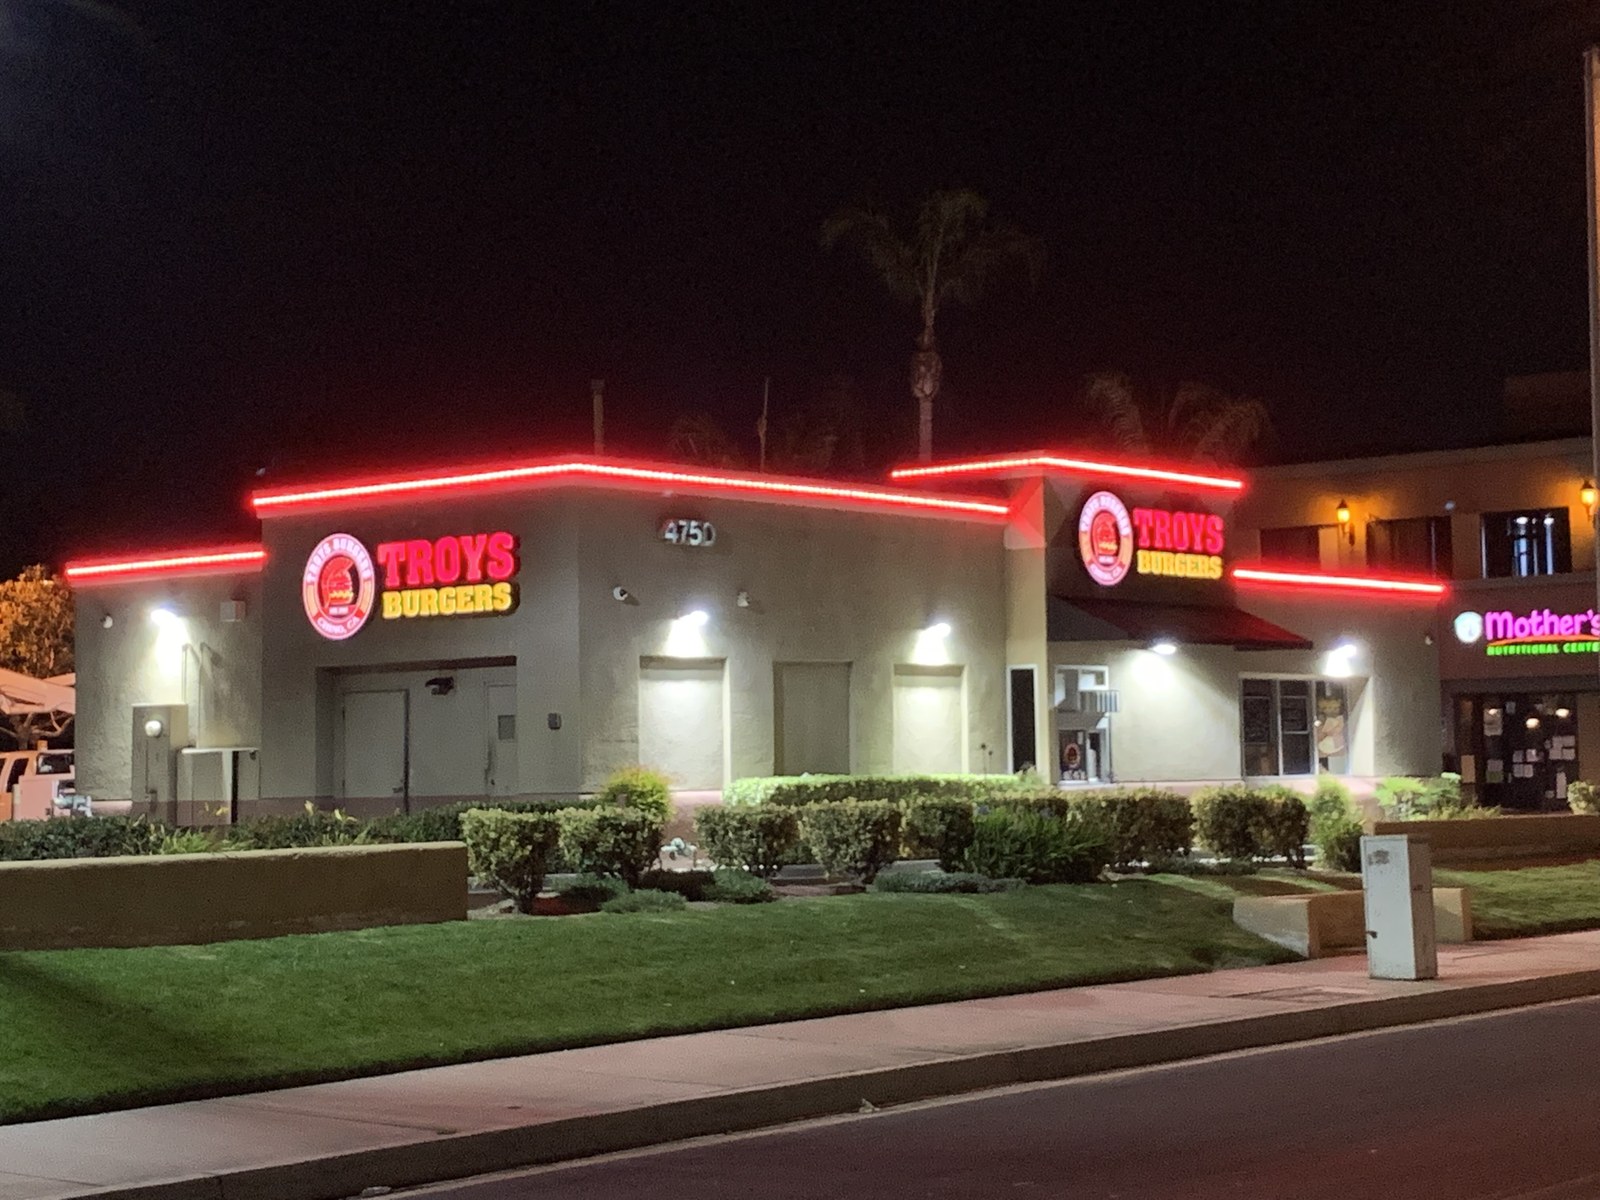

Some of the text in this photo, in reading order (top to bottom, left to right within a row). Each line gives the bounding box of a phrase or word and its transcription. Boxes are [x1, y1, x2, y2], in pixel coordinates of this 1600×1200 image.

[664, 519, 716, 546] 4750
[1132, 507, 1225, 554] TROYS
[377, 531, 515, 587] TROYS
[1136, 549, 1223, 580] BURGERS
[382, 582, 512, 619] BURGERS
[1485, 608, 1600, 640] Mother's
[1486, 643, 1560, 656] NUTRITIONAL
